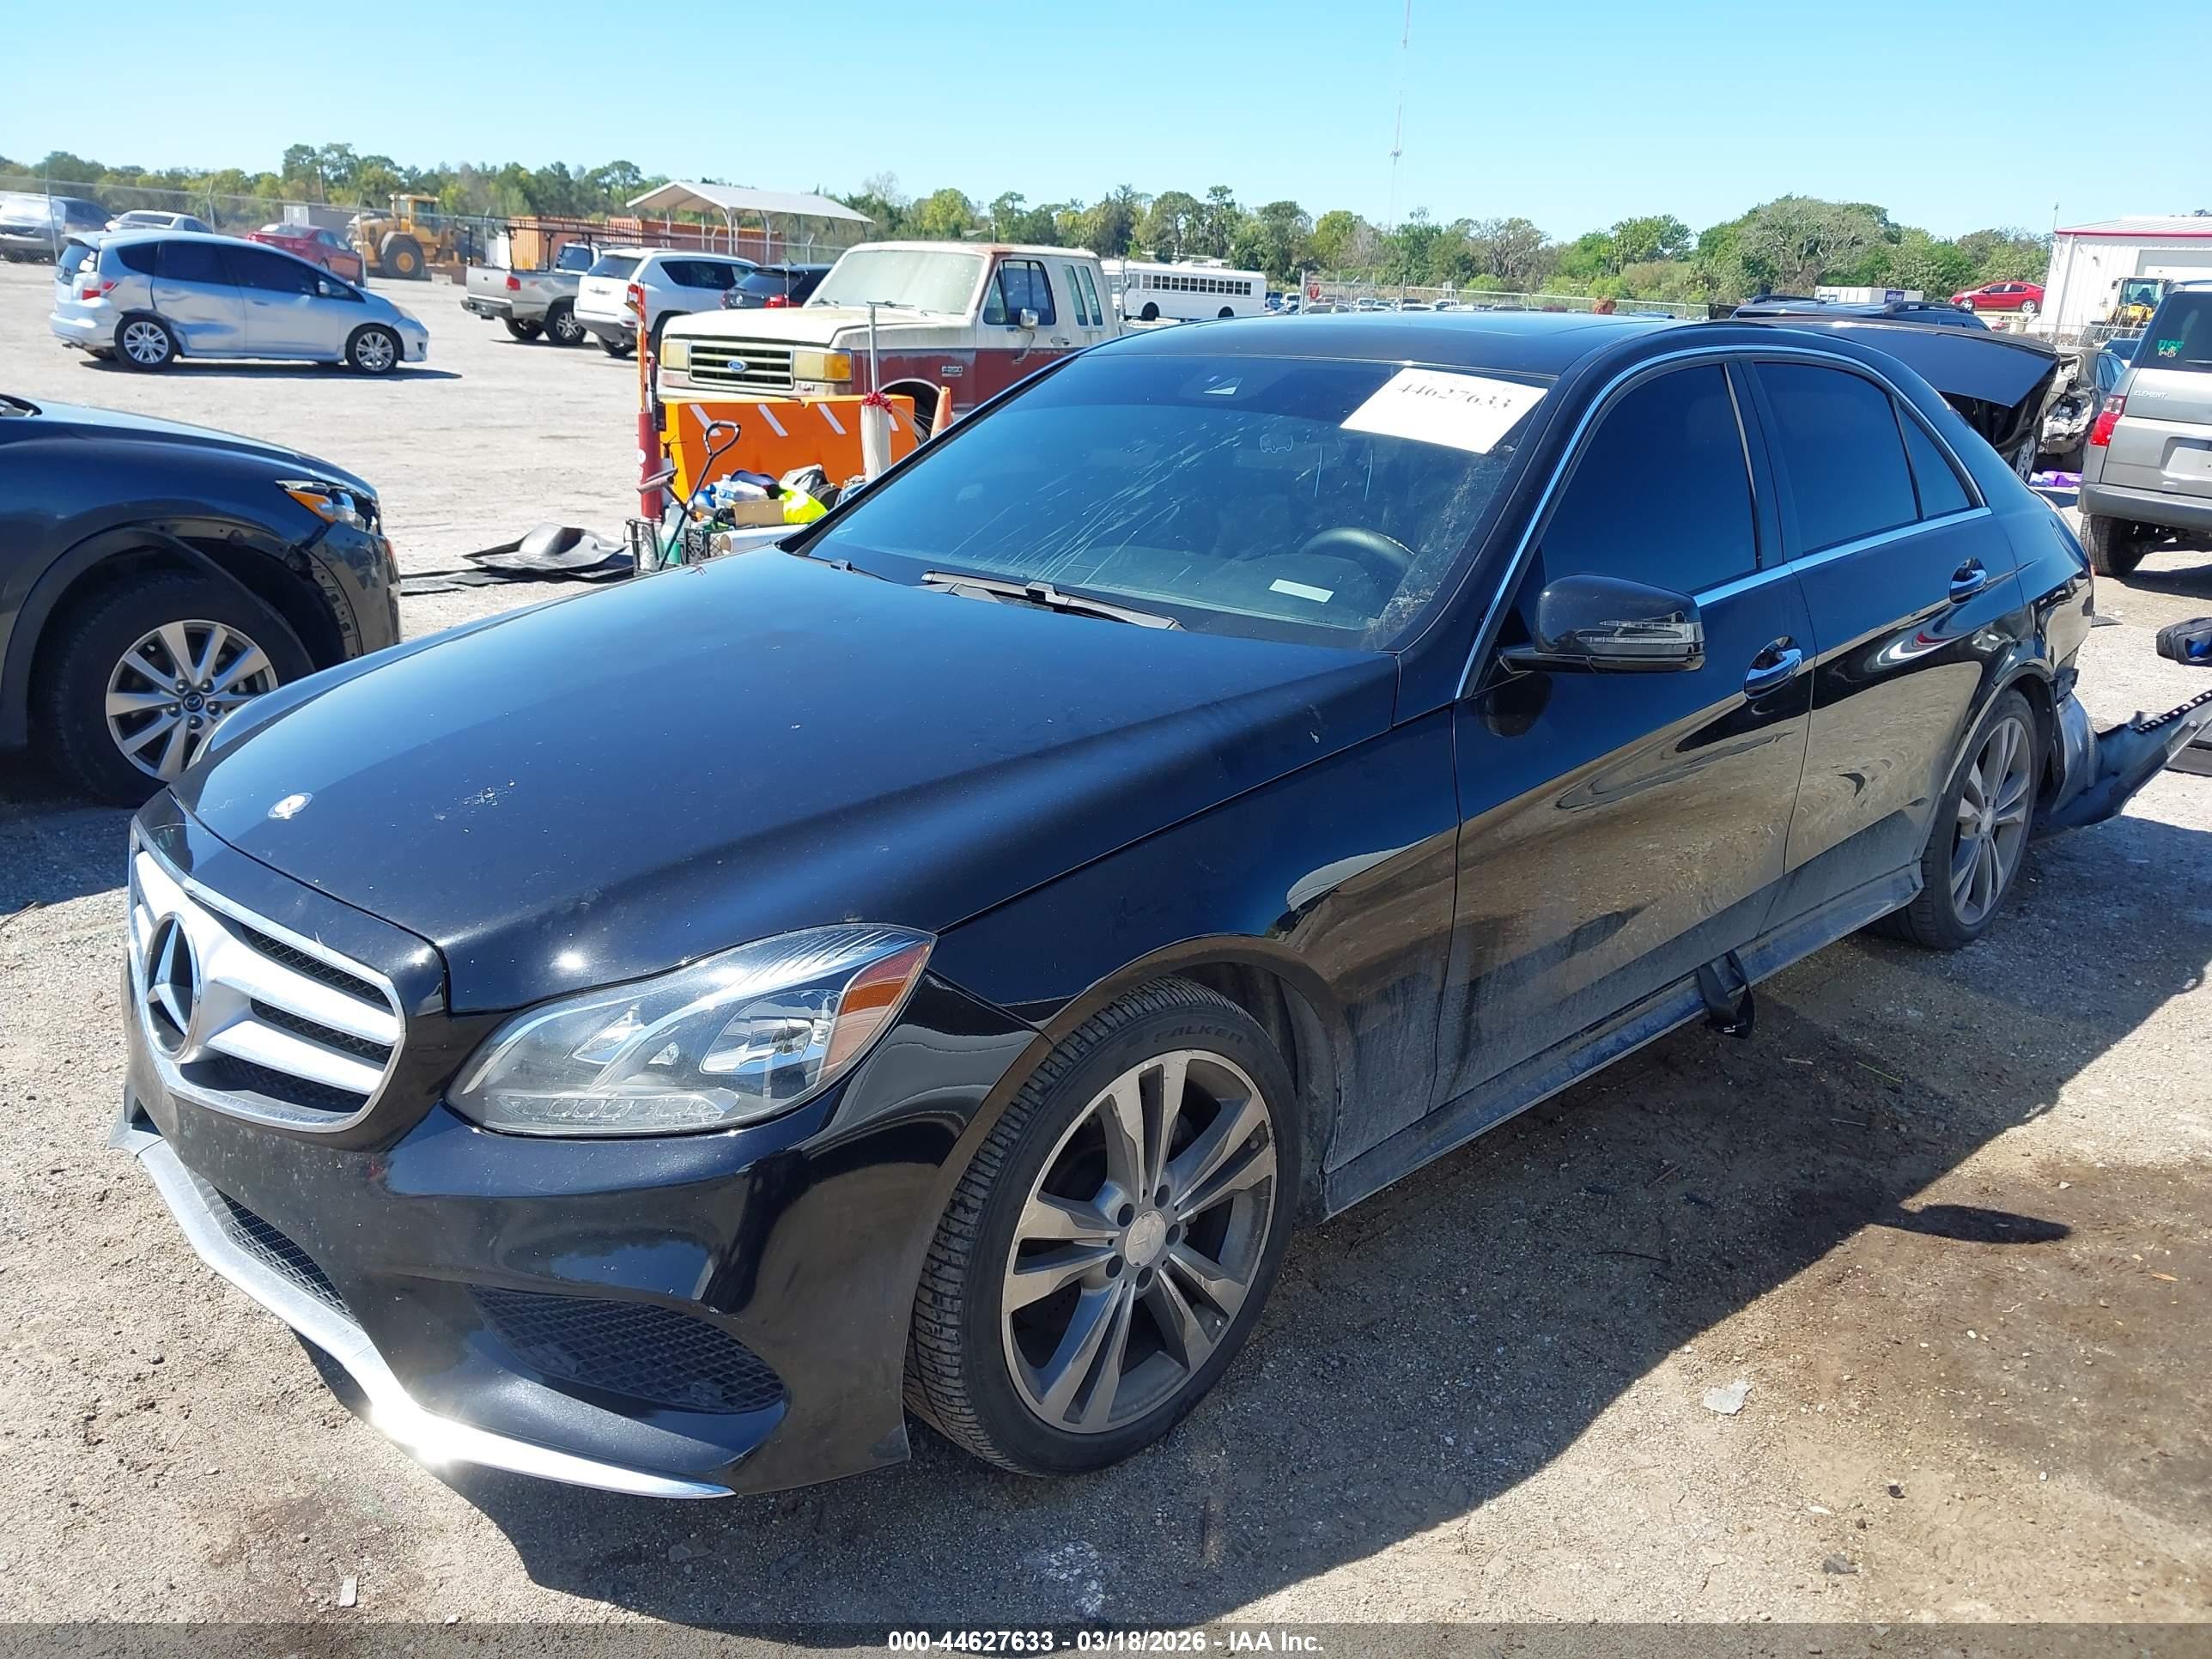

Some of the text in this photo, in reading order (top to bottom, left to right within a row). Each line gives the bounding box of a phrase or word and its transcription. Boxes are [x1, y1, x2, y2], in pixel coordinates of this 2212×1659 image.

[1397, 383, 1512, 409] 44627633
[2133, 390, 2167, 399] ELEMENT
[1153, 1025, 1243, 1044] FALKEN
